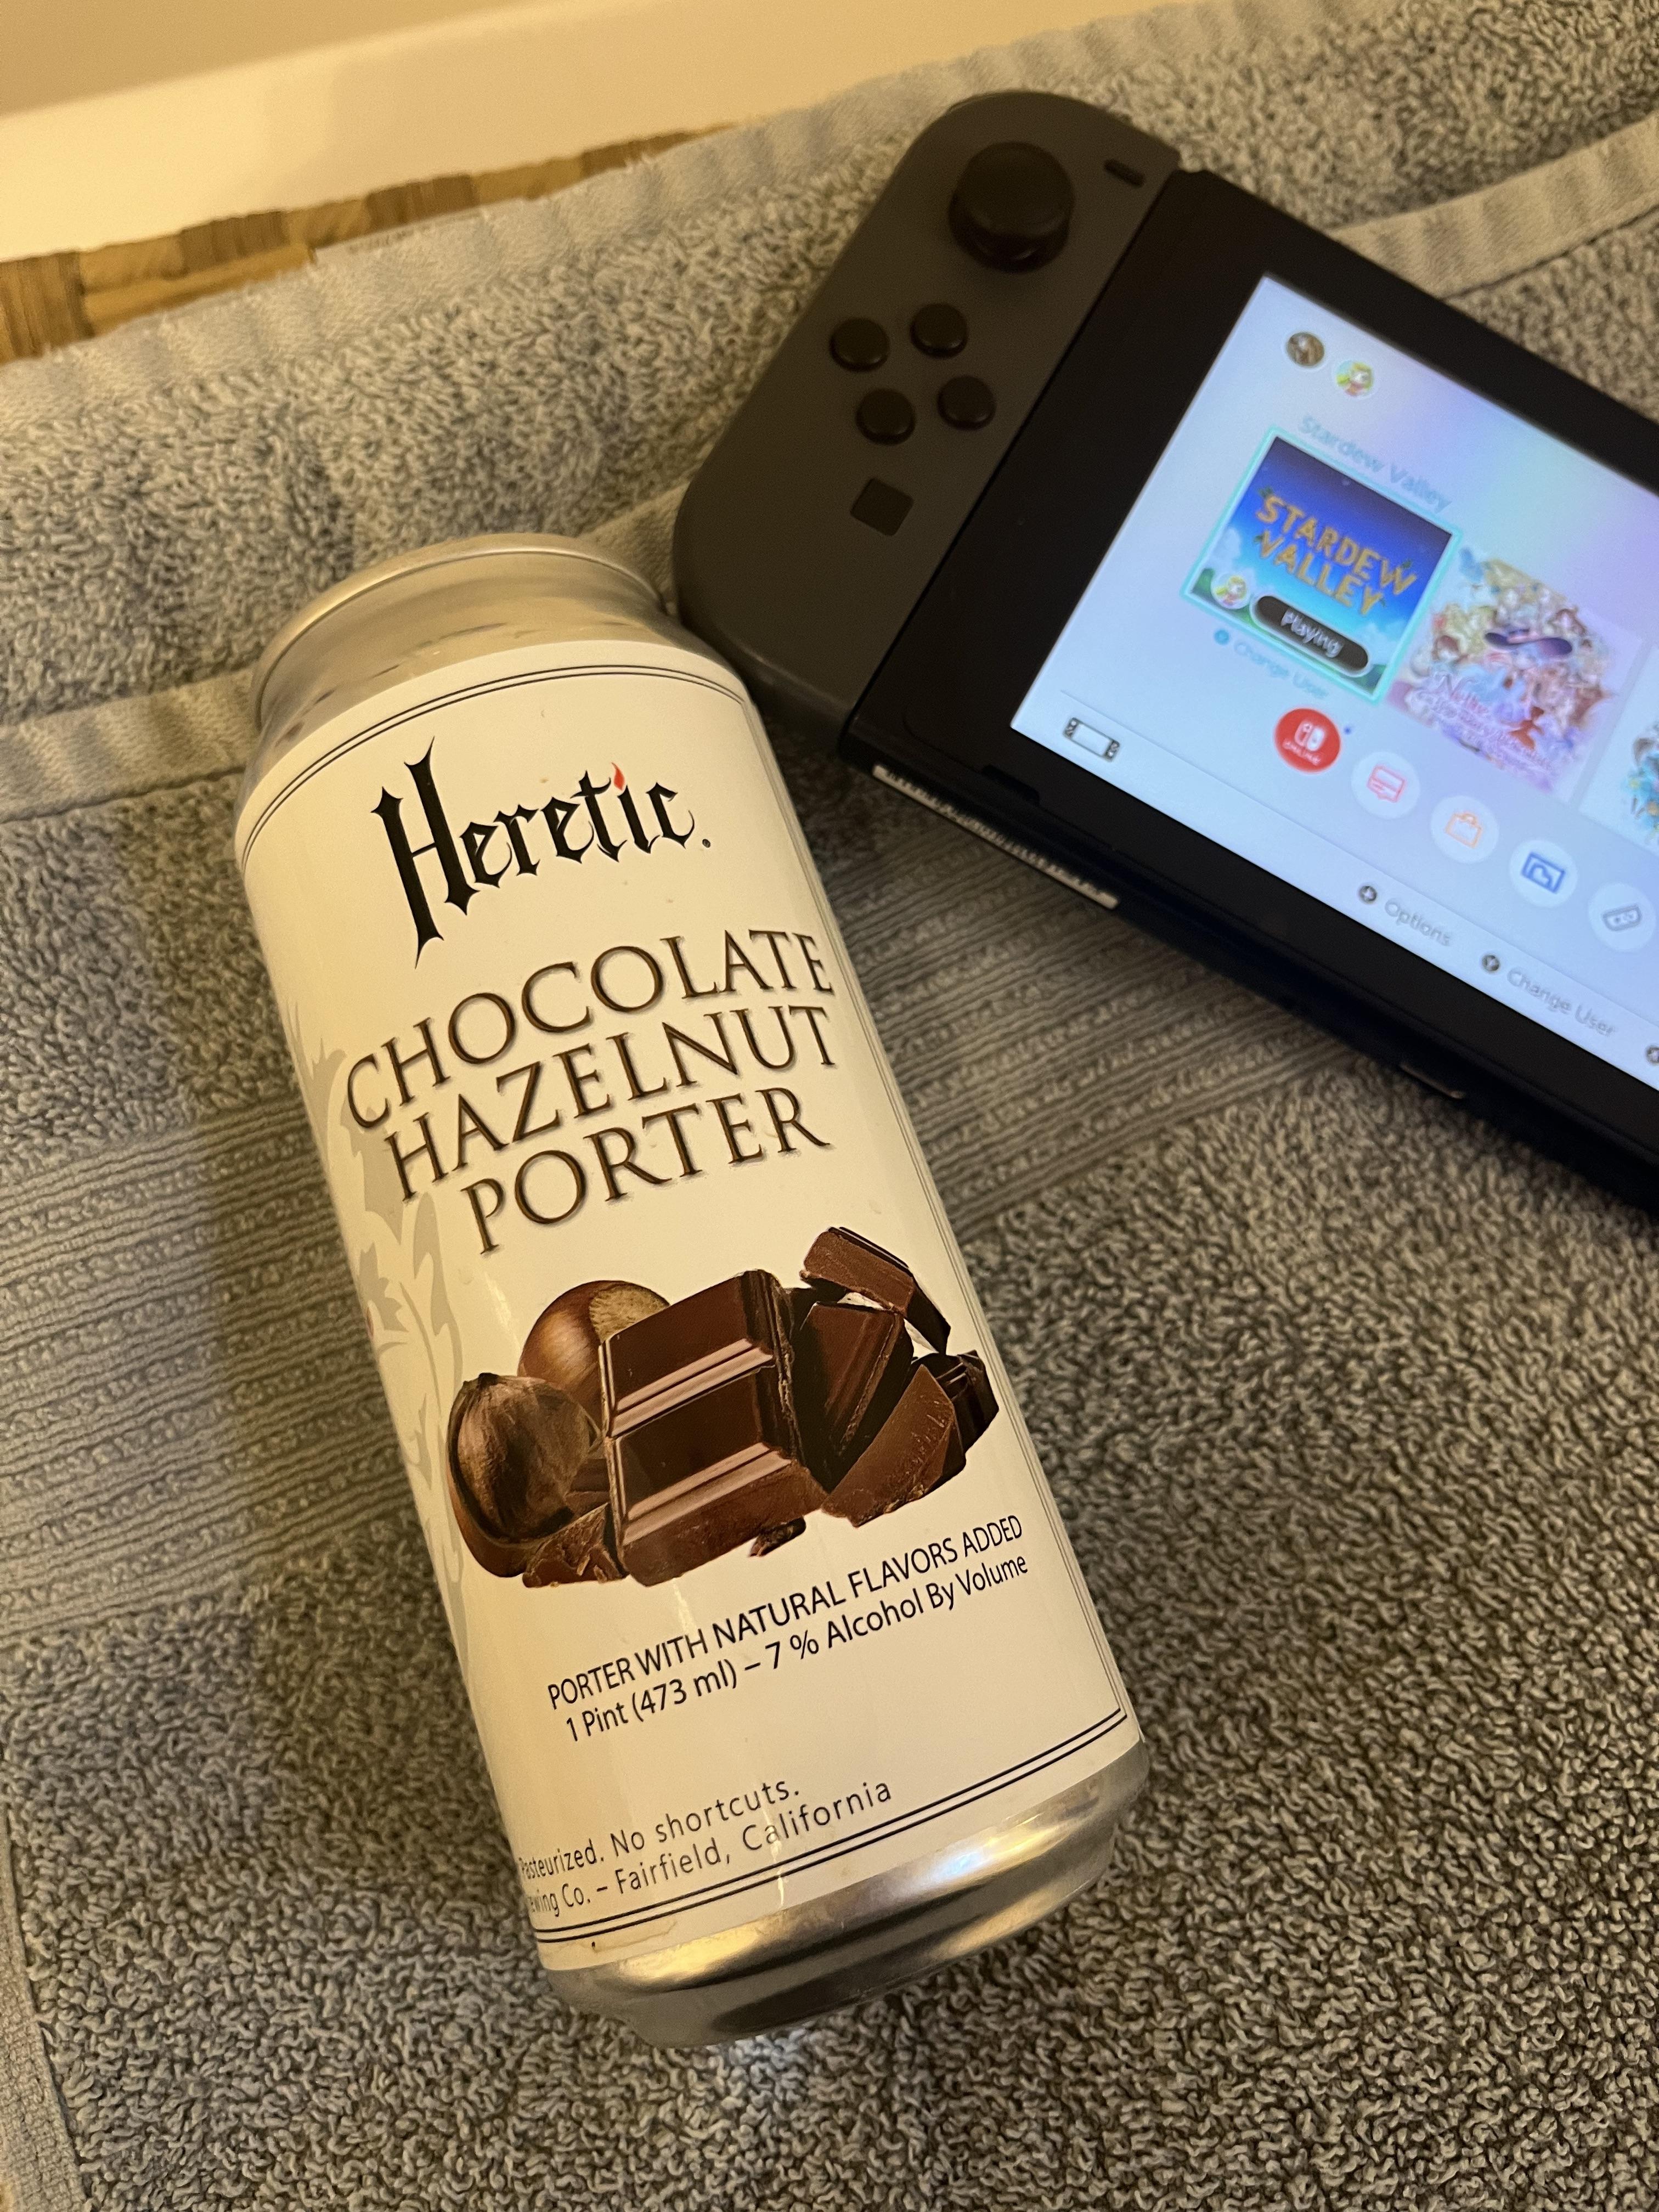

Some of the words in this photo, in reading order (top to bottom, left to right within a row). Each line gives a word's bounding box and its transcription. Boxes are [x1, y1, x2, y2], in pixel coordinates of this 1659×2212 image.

[1256, 495, 1418, 596] STARDEW
[1260, 530, 1383, 616] VALLEY
[1280, 609, 1344, 658] Playing
[371, 736, 695, 968] Heretic
[1384, 898, 1450, 946] Options
[346, 929, 834, 1128] CHOCOLATE
[1506, 967, 1572, 1015] Change
[1575, 1005, 1616, 1036] User
[384, 1006, 835, 1201] HAZELNUT
[461, 1087, 830, 1254] PORTER
[548, 1657, 635, 1709] PORTER
[634, 1628, 708, 1675] WITH
[712, 1581, 846, 1648] NATURAL
[848, 1537, 958, 1598] FLAVORS
[962, 1515, 1022, 1557] ADDED
[566, 1717, 578, 1741] 1
[582, 1702, 629, 1736] Pint
[632, 1679, 687, 1722] (473
[693, 1658, 737, 1696] ml)
[765, 1641, 781, 1669] 7
[789, 1630, 820, 1660] %
[826, 1588, 924, 1649] Alcohol
[926, 1582, 953, 1611] By
[955, 1556, 1028, 1595] Volume
[561, 1883, 591, 1908] Co.
[614, 1837, 730, 1894] Fairfield,
[742, 1782, 891, 1850] California
[610, 1830, 645, 1857] No
[655, 1780, 799, 1843] shortcuts.
